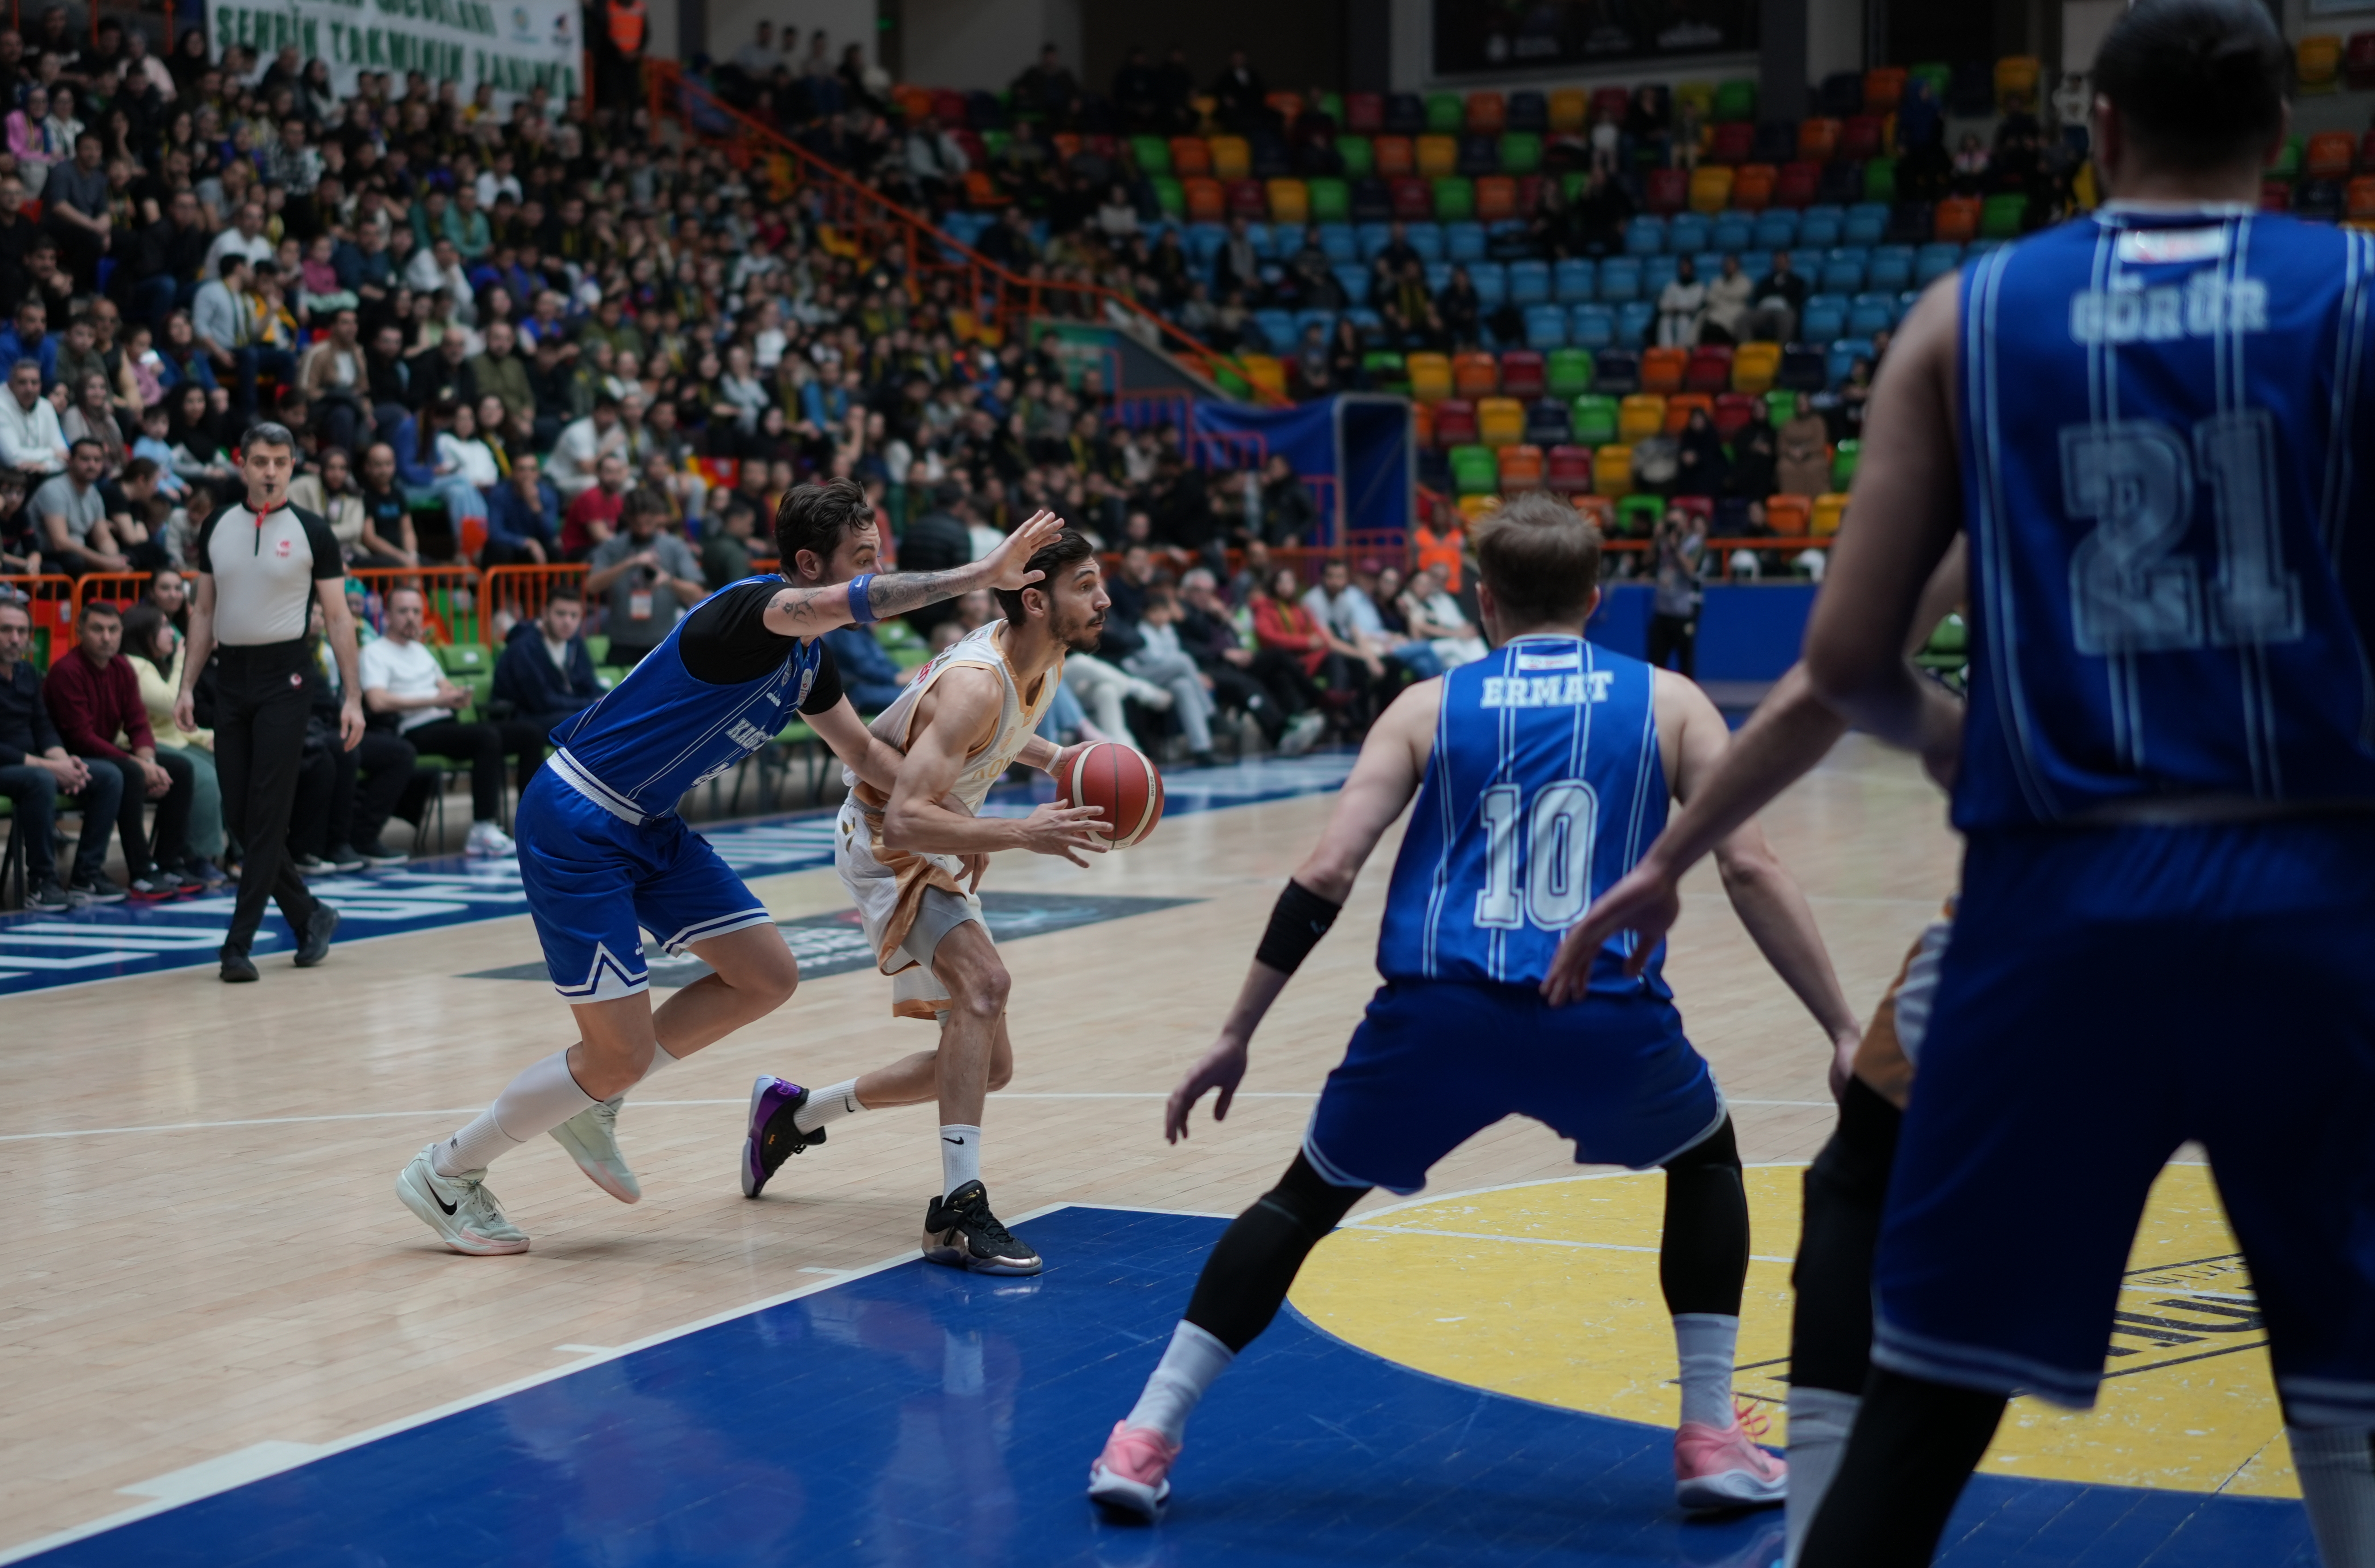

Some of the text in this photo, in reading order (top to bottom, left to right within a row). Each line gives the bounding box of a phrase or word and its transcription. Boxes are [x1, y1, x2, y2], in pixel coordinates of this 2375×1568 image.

[2070, 269, 2270, 345] GÖRÜR
[2059, 410, 2304, 655] 21
[1480, 670, 1614, 708] ERMAT
[1474, 779, 1598, 932] 10
